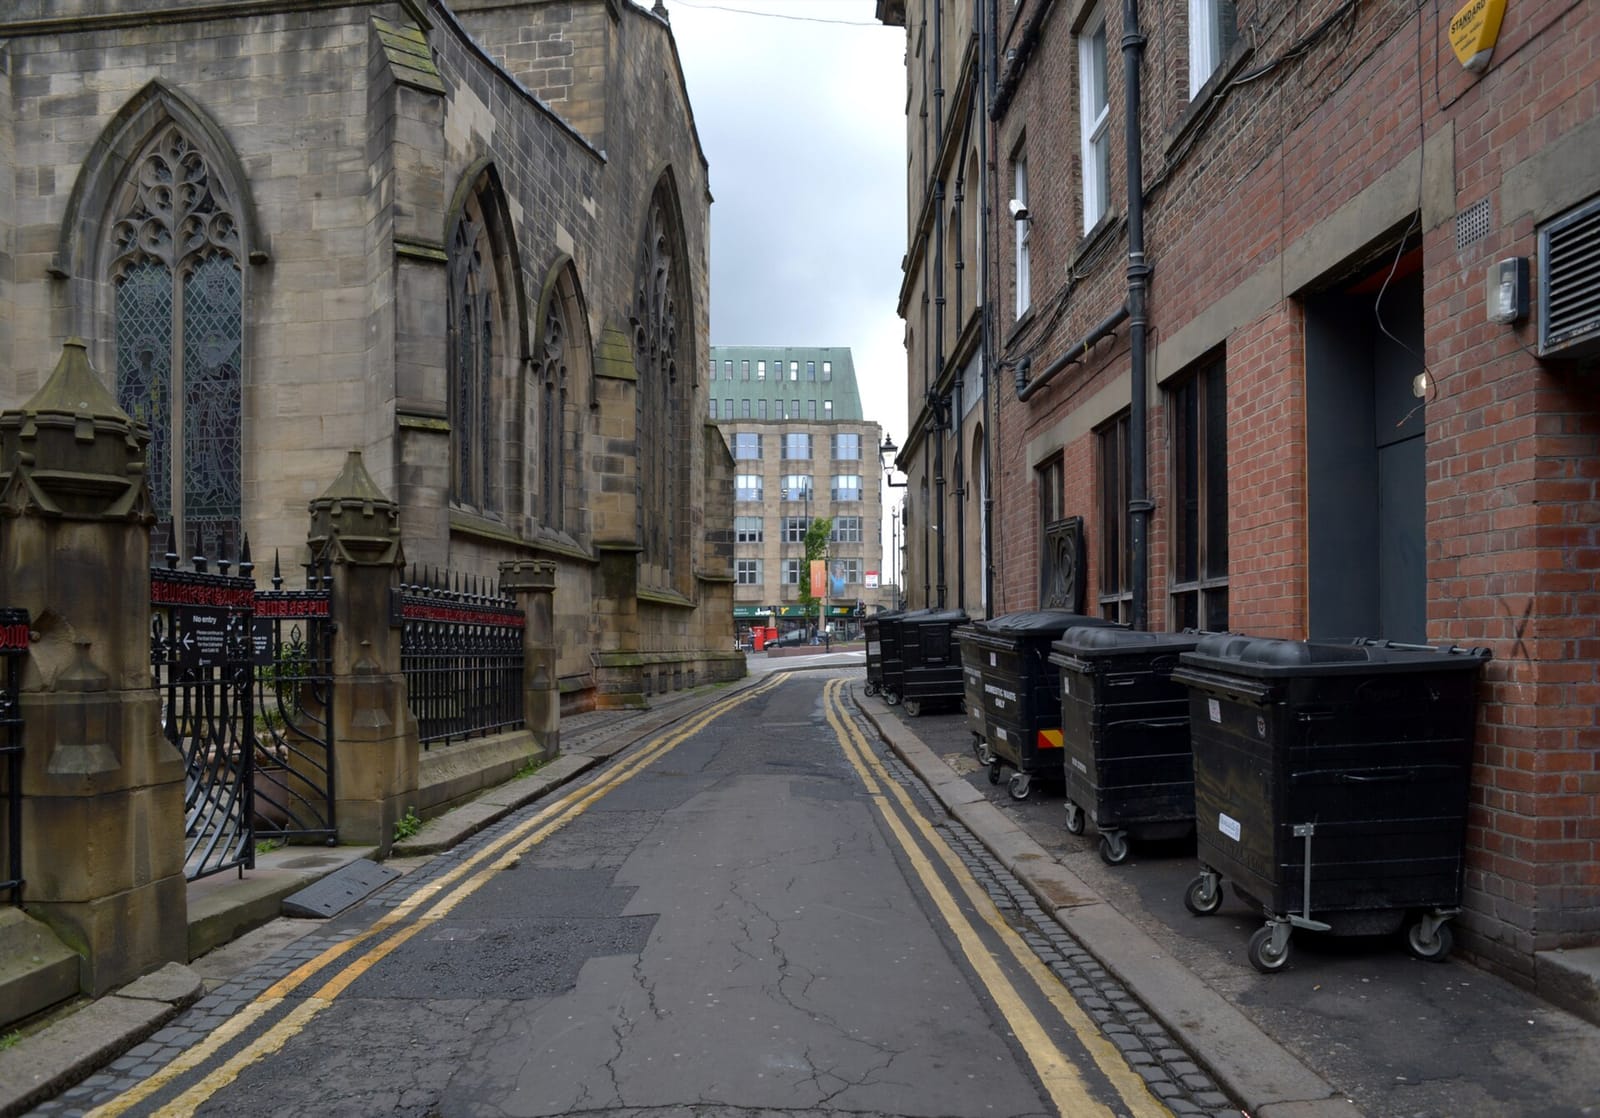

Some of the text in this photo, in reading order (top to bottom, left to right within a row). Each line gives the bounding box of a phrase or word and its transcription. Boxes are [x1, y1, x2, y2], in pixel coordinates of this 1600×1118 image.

[1451, 0, 1486, 34] STANDARD
[193, 615, 217, 625] No entry
